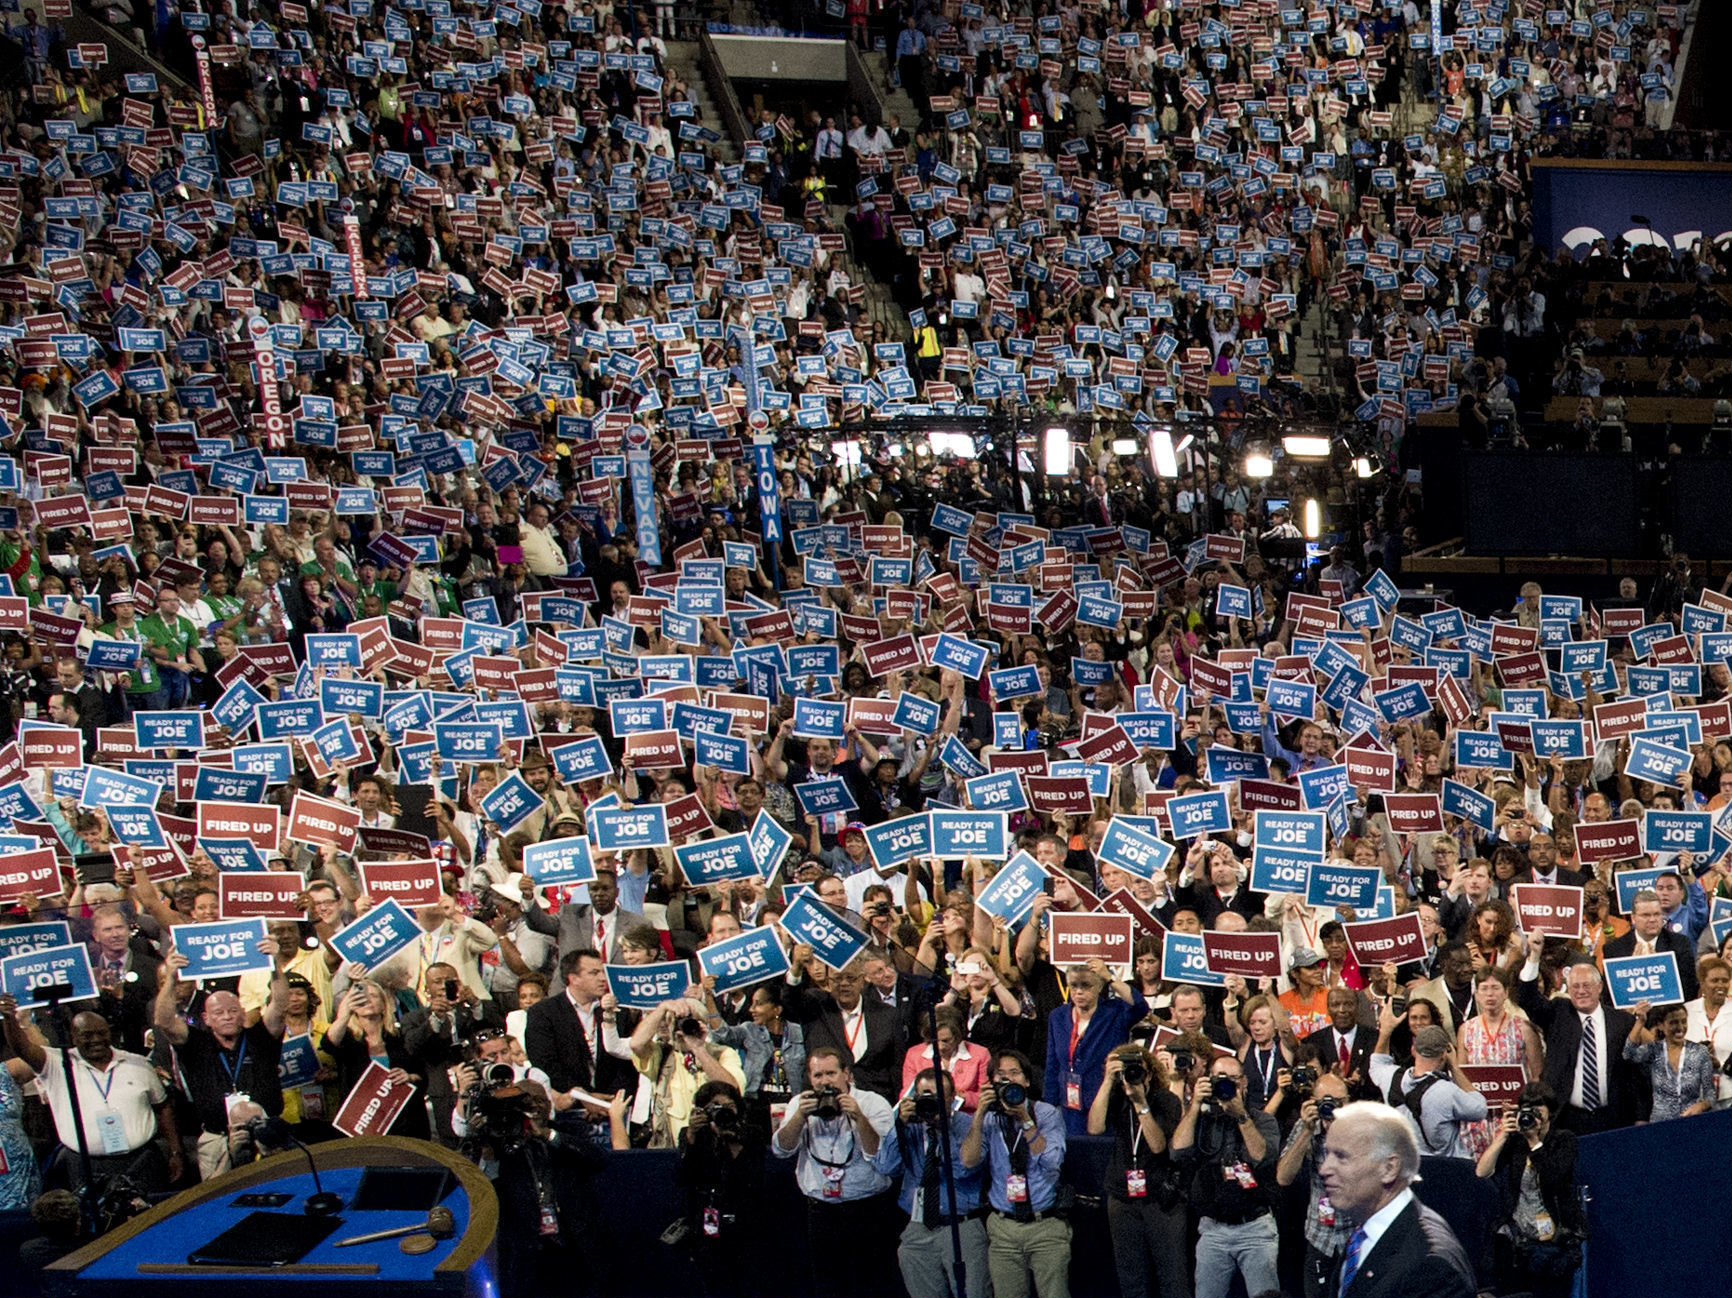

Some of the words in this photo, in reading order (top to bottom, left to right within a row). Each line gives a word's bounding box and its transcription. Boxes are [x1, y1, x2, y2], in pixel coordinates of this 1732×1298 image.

[348, 224, 368, 298] CALIFORNIA
[258, 353, 285, 447] OREGON
[759, 449, 778, 538] IOWA
[41, 509, 70, 519] FIRED
[71, 506, 84, 514] UP
[633, 463, 659, 562] NEVADA
[802, 707, 824, 715] READY
[806, 714, 834, 727] JOE
[154, 726, 186, 738] JOE
[1131, 727, 1160, 738] JOE
[25, 744, 54, 754] FIRED
[57, 745, 76, 754] UP
[454, 739, 486, 750] JOE
[1035, 791, 1066, 800] FIRED
[1069, 791, 1085, 800] UP
[605, 816, 634, 825] READY
[637, 814, 655, 823] FOR
[1391, 810, 1419, 819] FIRED
[1421, 810, 1435, 819] UP
[206, 821, 250, 832] FIRED
[253, 823, 272, 833] UP
[615, 824, 649, 837] JOE
[1265, 821, 1294, 830] READY
[1297, 821, 1315, 830] FOR
[1655, 820, 1683, 828] READY
[1686, 820, 1703, 829] FOR
[878, 828, 906, 842] READY
[908, 823, 926, 834] FOR
[1273, 830, 1306, 843] JOE
[1662, 829, 1695, 842] JOE
[890, 832, 923, 850] JOE
[1115, 831, 1142, 849] READY
[1143, 842, 1160, 857] FOR
[1582, 838, 1616, 849] FIRED
[1619, 835, 1635, 845] UP
[532, 851, 560, 862] READY
[563, 848, 580, 857] FOR
[688, 850, 718, 862] READY
[721, 845, 741, 856] FOR
[1117, 844, 1150, 866] JOE
[540, 858, 574, 873] JOE
[703, 855, 737, 873] JOE
[371, 881, 410, 891] FIRED
[414, 879, 434, 889] UP
[1319, 874, 1350, 884] READY
[1352, 876, 1370, 884] FOR
[228, 892, 274, 902] FIRED
[278, 892, 299, 902] UP
[1326, 884, 1360, 898] JOE
[1520, 905, 1550, 916] FIRED
[1556, 907, 1575, 917] UP
[804, 904, 835, 932] READY
[830, 925, 853, 944] FOR
[187, 935, 227, 945] READY
[230, 931, 253, 941] FOR
[802, 919, 840, 950] JOE
[1058, 933, 1101, 945] FIRED
[1105, 935, 1125, 945] UP
[1355, 938, 1394, 951] FIRED
[1397, 933, 1416, 946] UP
[201, 942, 246, 960] JOE
[711, 952, 742, 965] READY
[746, 940, 767, 953] FOR
[1211, 949, 1250, 961] FIRED
[1254, 951, 1274, 961] UP
[13, 962, 47, 976] READY
[51, 958, 75, 969] FOR
[726, 952, 765, 976] JOE
[1182, 955, 1206, 970] JO
[656, 972, 677, 981] FOR
[1616, 968, 1644, 978] READY
[1648, 965, 1666, 975] FOR
[26, 970, 70, 991] JOE
[1627, 975, 1661, 993] JOE
[630, 981, 670, 997] JOE
[1472, 1083, 1499, 1091] RED
[1503, 1082, 1521, 1091] UP
[354, 1097, 381, 1135] FIRED
[377, 1079, 392, 1098] UP
